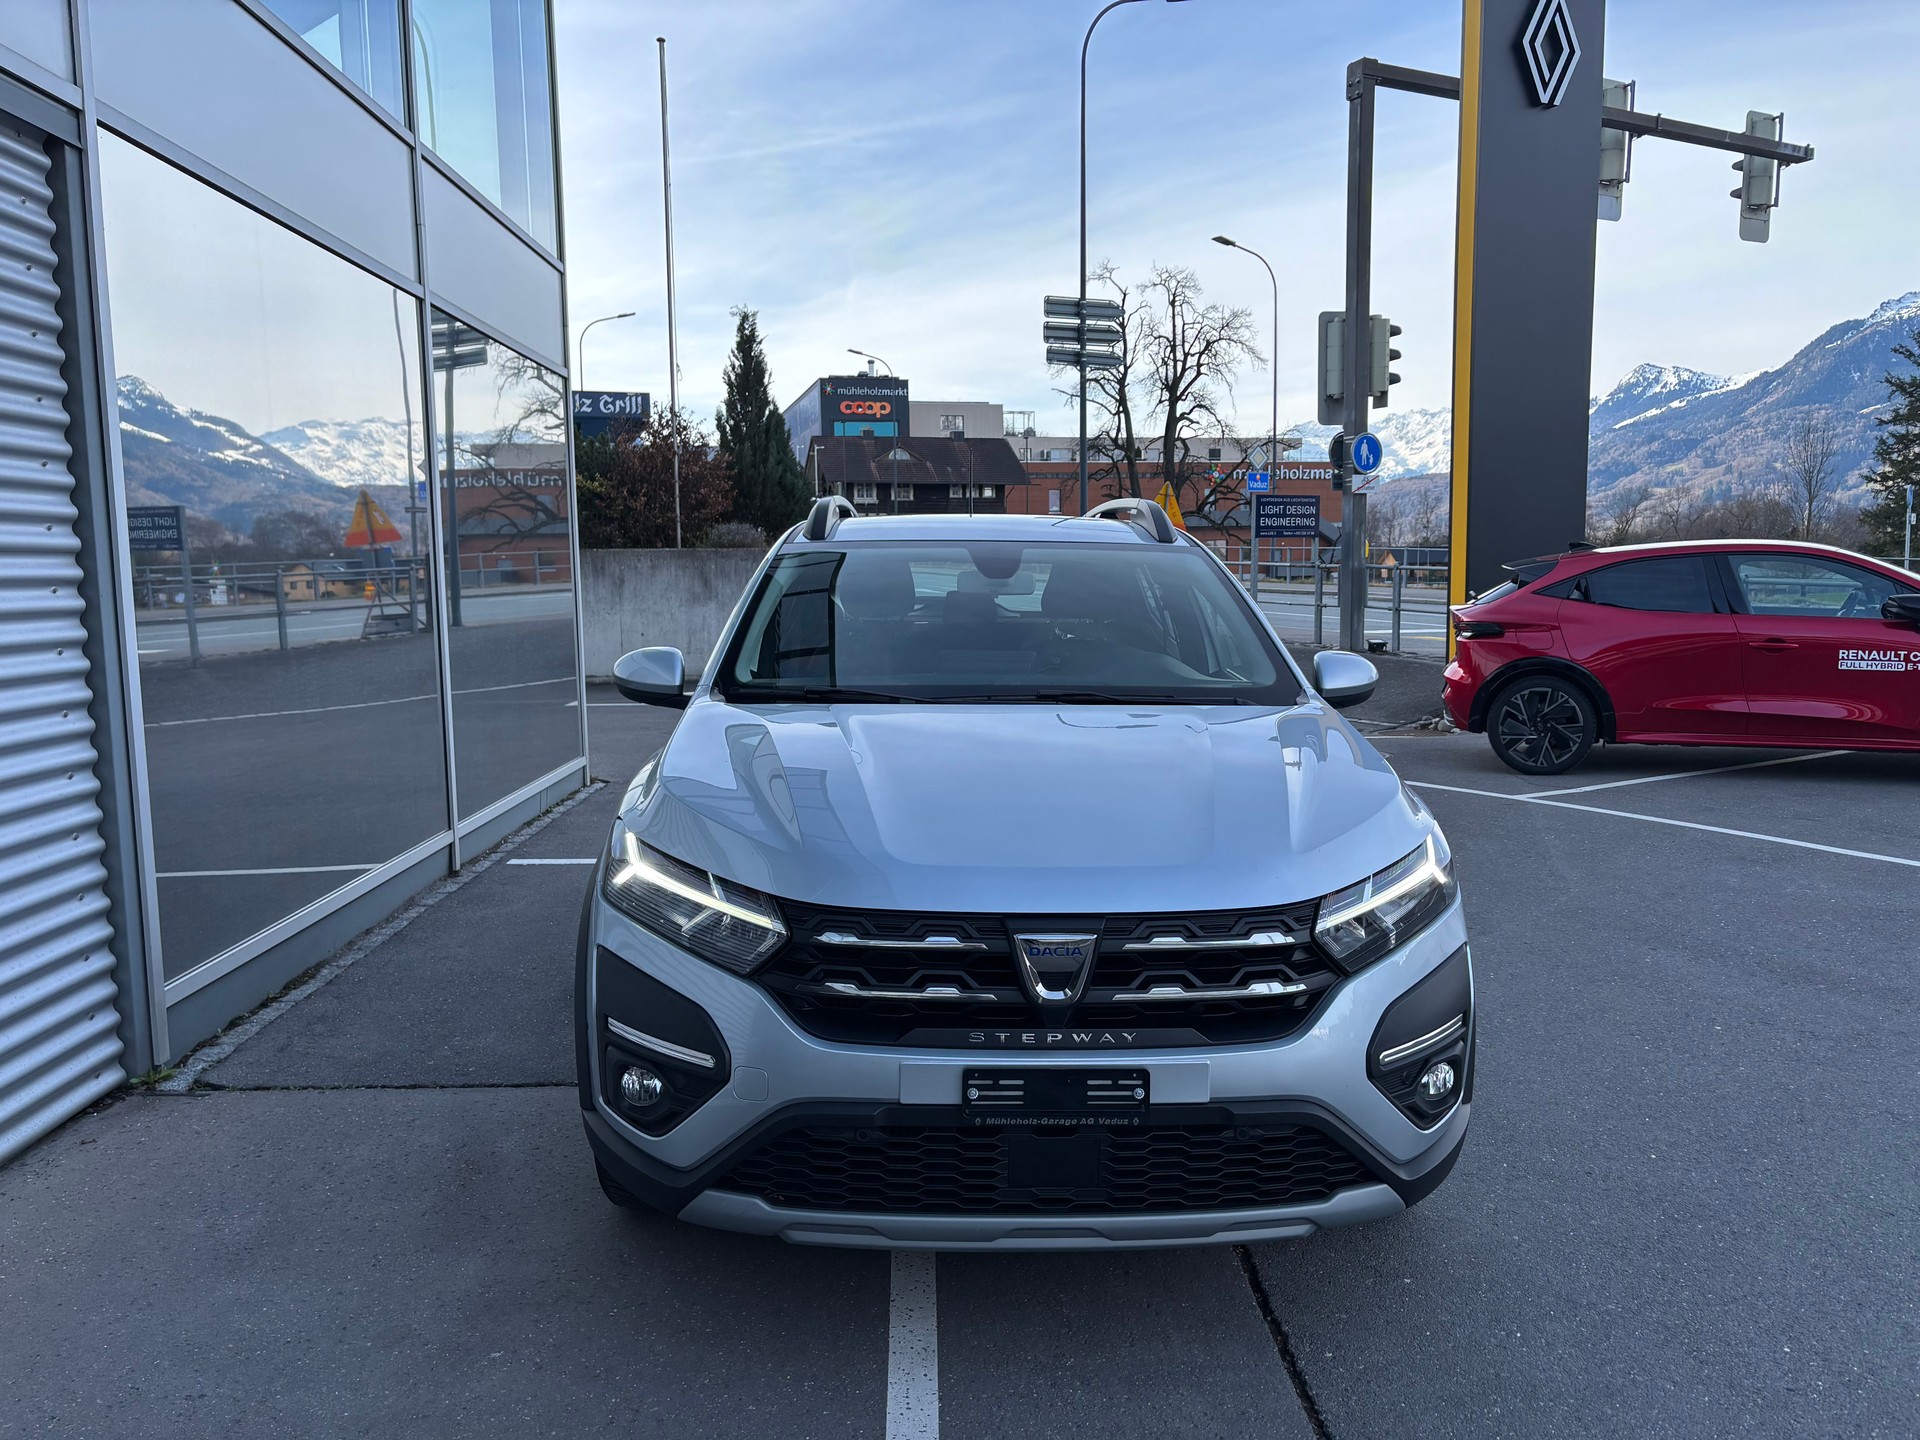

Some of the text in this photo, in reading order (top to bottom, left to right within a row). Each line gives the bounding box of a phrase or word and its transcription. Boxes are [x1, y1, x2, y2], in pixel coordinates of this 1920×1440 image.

[837, 386, 908, 397] mühleholzmarkt
[599, 394, 642, 415] Grill
[840, 400, 892, 418] coop
[1249, 480, 1268, 489] Vaduz
[1260, 505, 1316, 515] LIGHT DESIGN
[1260, 517, 1316, 527] ENGINEERING
[1838, 649, 1908, 661] RENAULT
[1839, 661, 1864, 669] FULL
[1865, 662, 1904, 670] HYBRID
[1028, 946, 1083, 957] DACIA
[968, 1032, 1137, 1044] STEPWAY
[985, 1116, 1129, 1126] Mühleholz-Garage AG Vaduz
